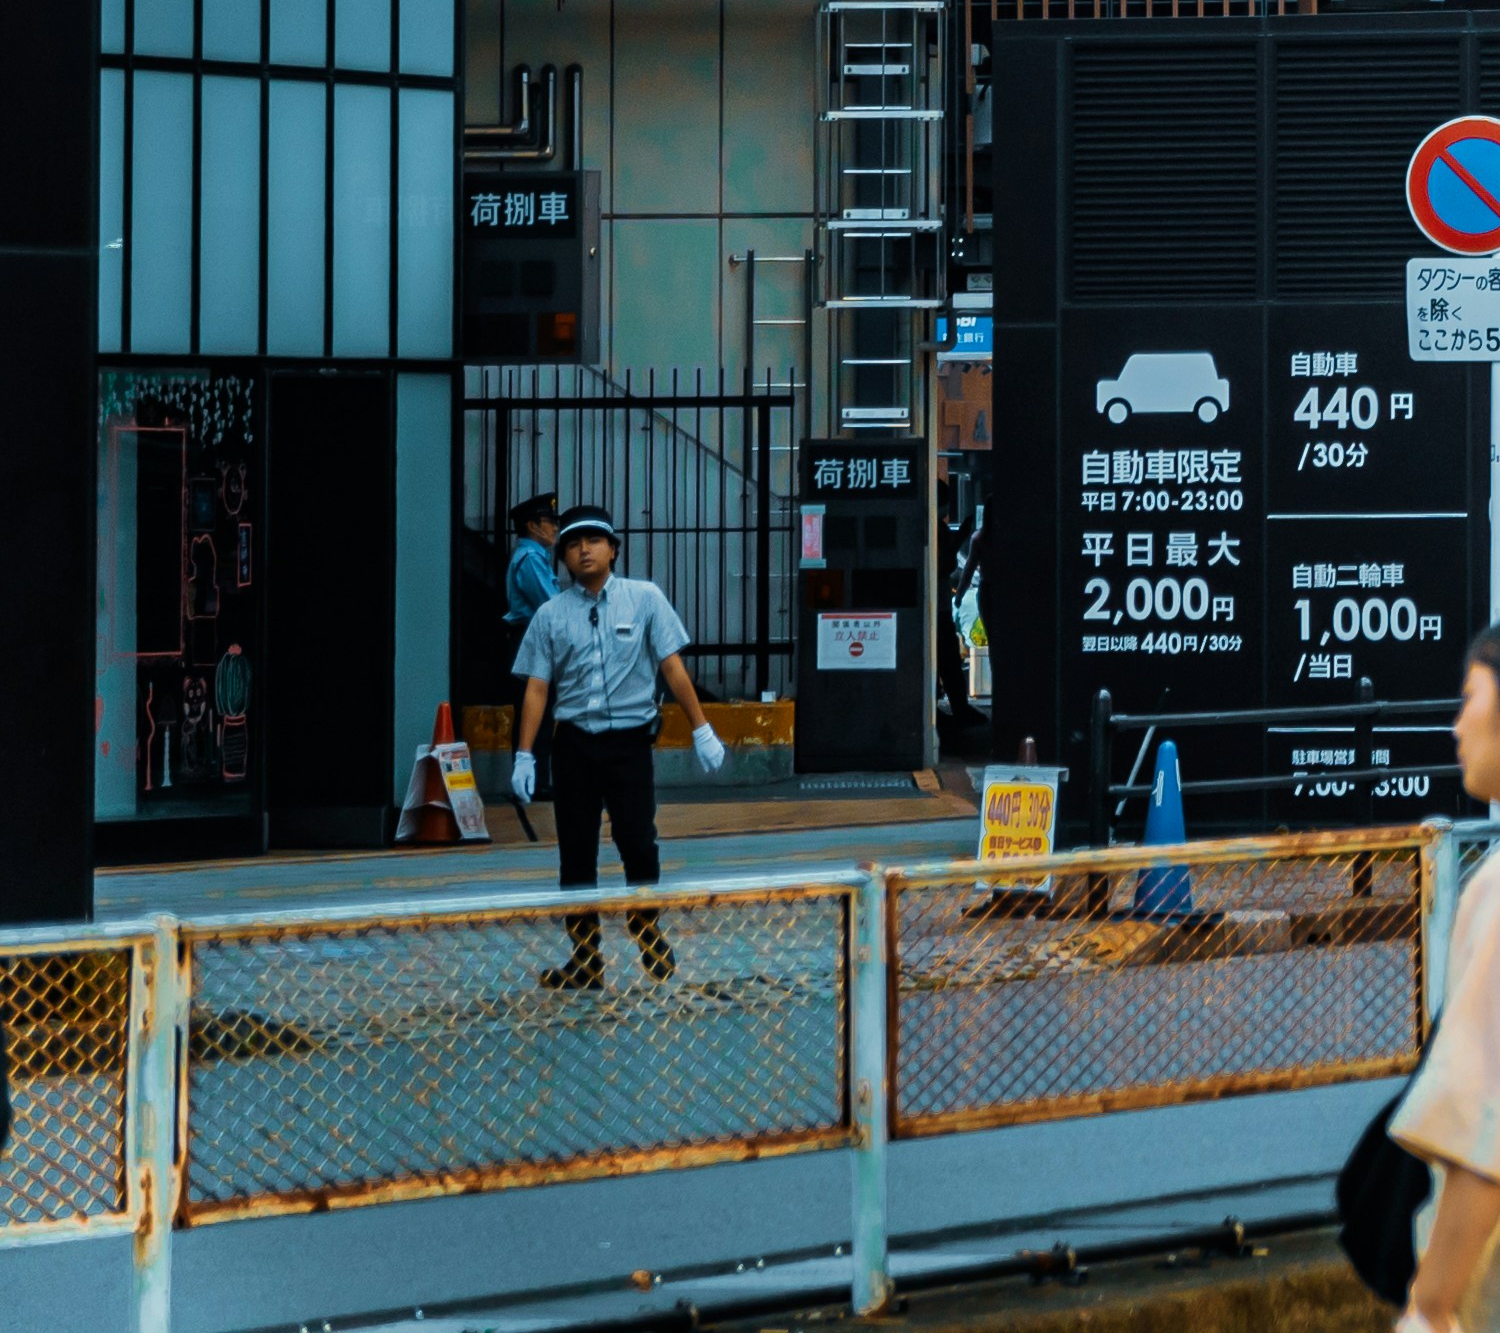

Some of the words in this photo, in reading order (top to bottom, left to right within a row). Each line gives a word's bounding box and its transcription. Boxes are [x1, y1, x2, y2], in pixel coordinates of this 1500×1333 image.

[470, 192, 569, 226] 荷捌車
[1417, 298, 1462, 322] を除く
[1291, 351, 1358, 377] 自動車
[813, 458, 912, 490] 荷捌車
[1082, 449, 1243, 484] 自動車限定
[1081, 492, 1116, 511] 平日
[1122, 490, 1243, 511] 7:00-23:00
[1081, 531, 1241, 567] 平日最大
[1292, 563, 1405, 588] 自動二輪車
